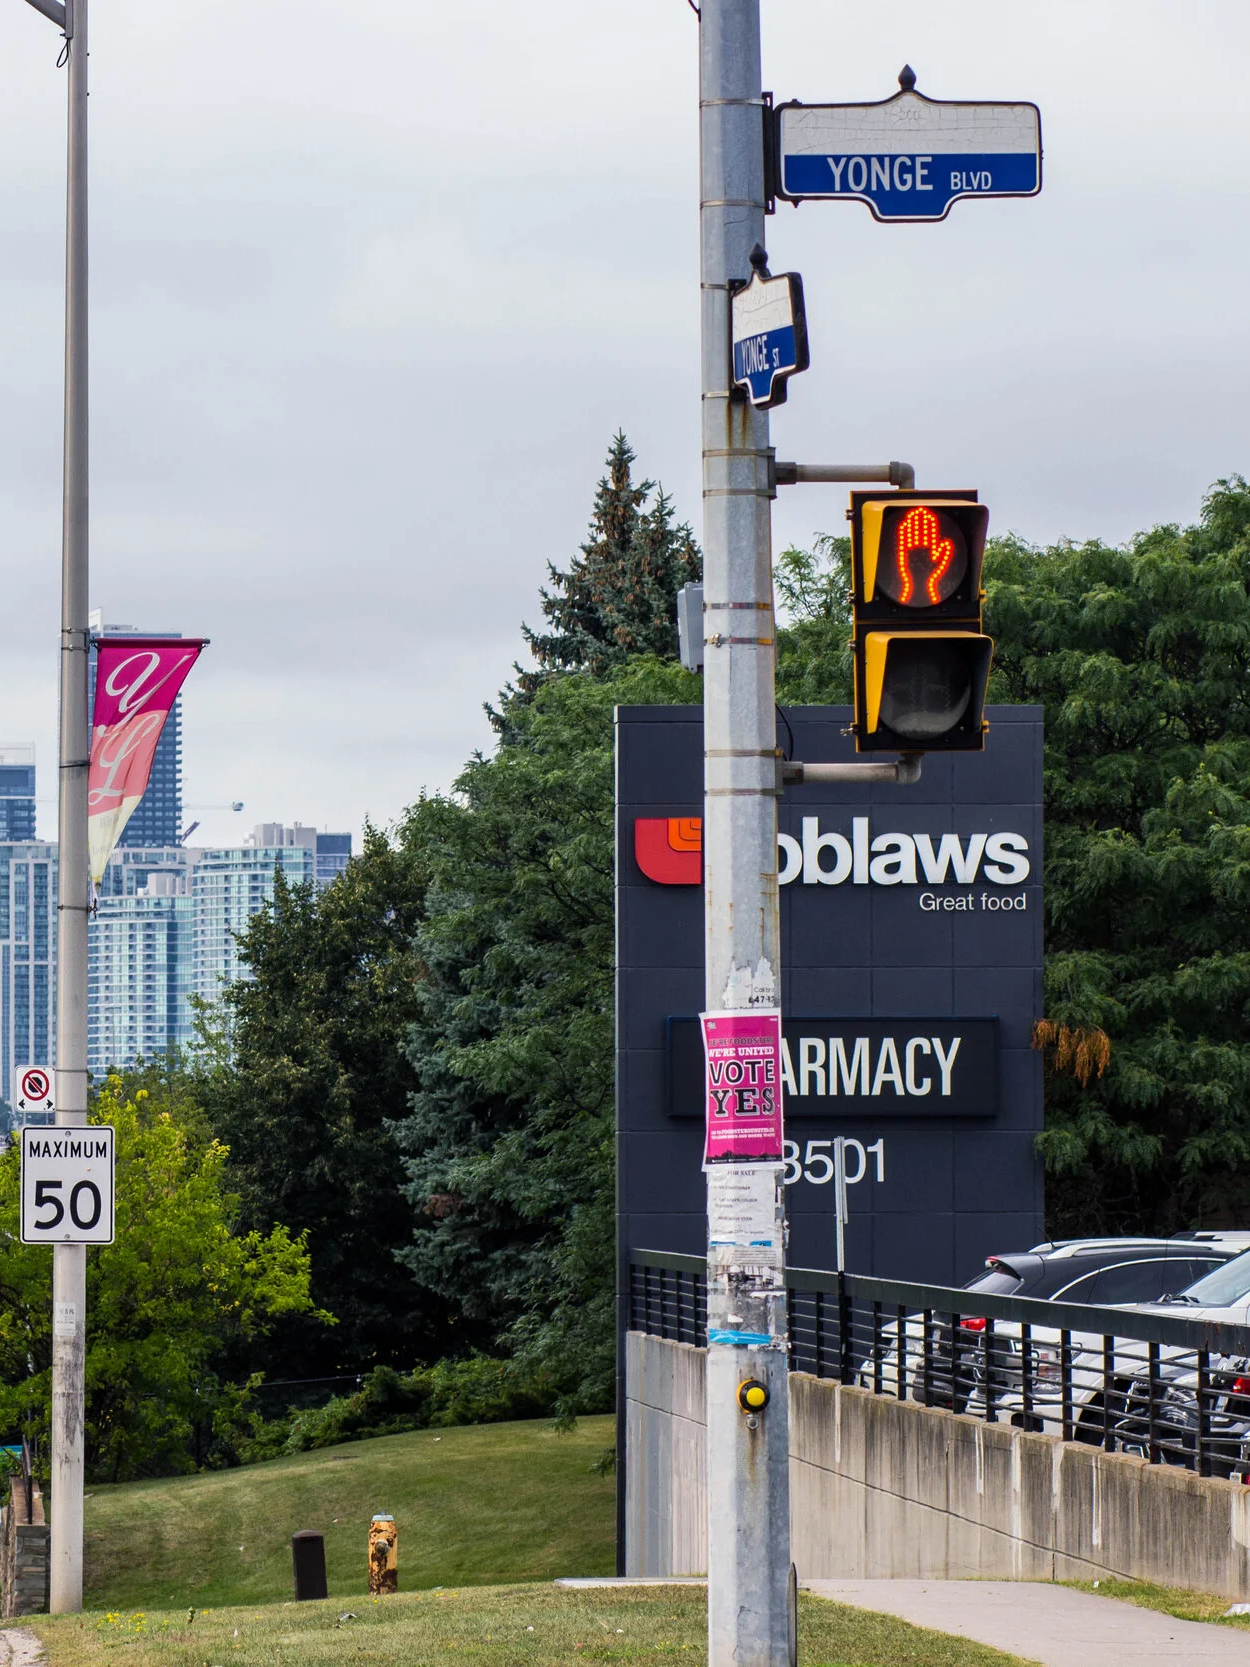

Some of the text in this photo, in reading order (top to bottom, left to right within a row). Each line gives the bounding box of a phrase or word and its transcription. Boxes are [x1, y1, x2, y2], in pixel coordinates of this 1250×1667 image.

[827, 156, 993, 192] YONGE BLVD
[741, 335, 780, 376] YONGE ST
[919, 892, 1027, 911] Great food
[709, 1046, 774, 1058] WE'RE UNITED
[709, 1059, 775, 1086] VOTE
[710, 1087, 775, 1118] YES
[29, 1140, 107, 1158] MAXIMUM
[34, 1180, 102, 1230] 50
